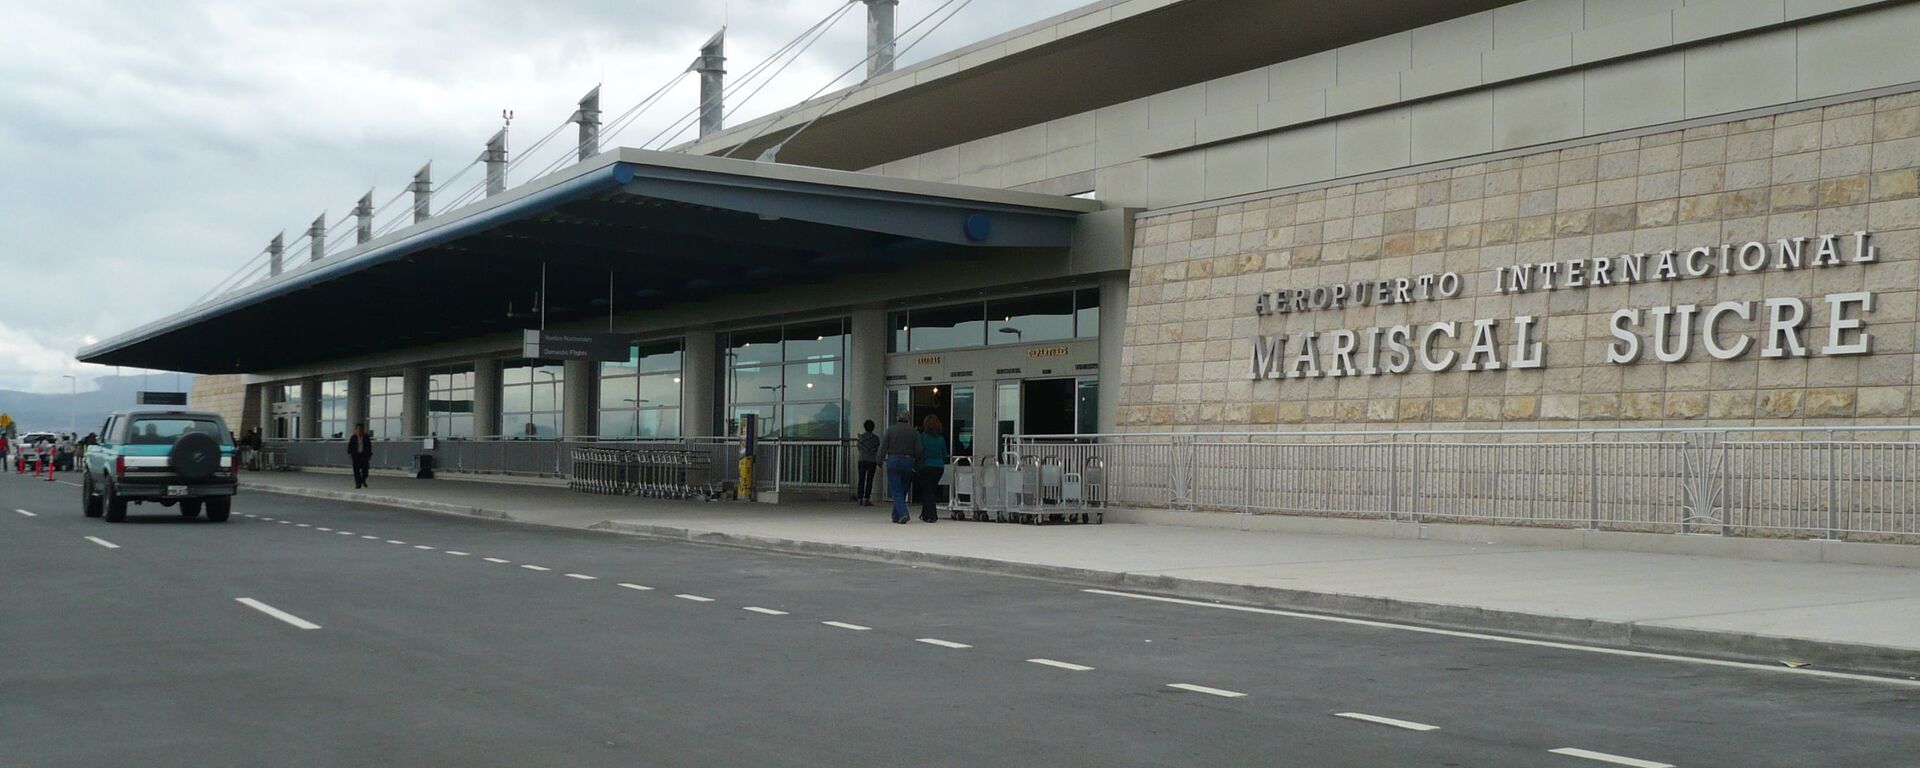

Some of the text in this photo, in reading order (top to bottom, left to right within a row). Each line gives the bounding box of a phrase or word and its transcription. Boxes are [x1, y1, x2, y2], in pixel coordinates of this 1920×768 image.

[1256, 231, 1876, 315] AEROPUERTO INTERNACIONAL
[1251, 292, 1875, 381] MARISCAL SUCRE
